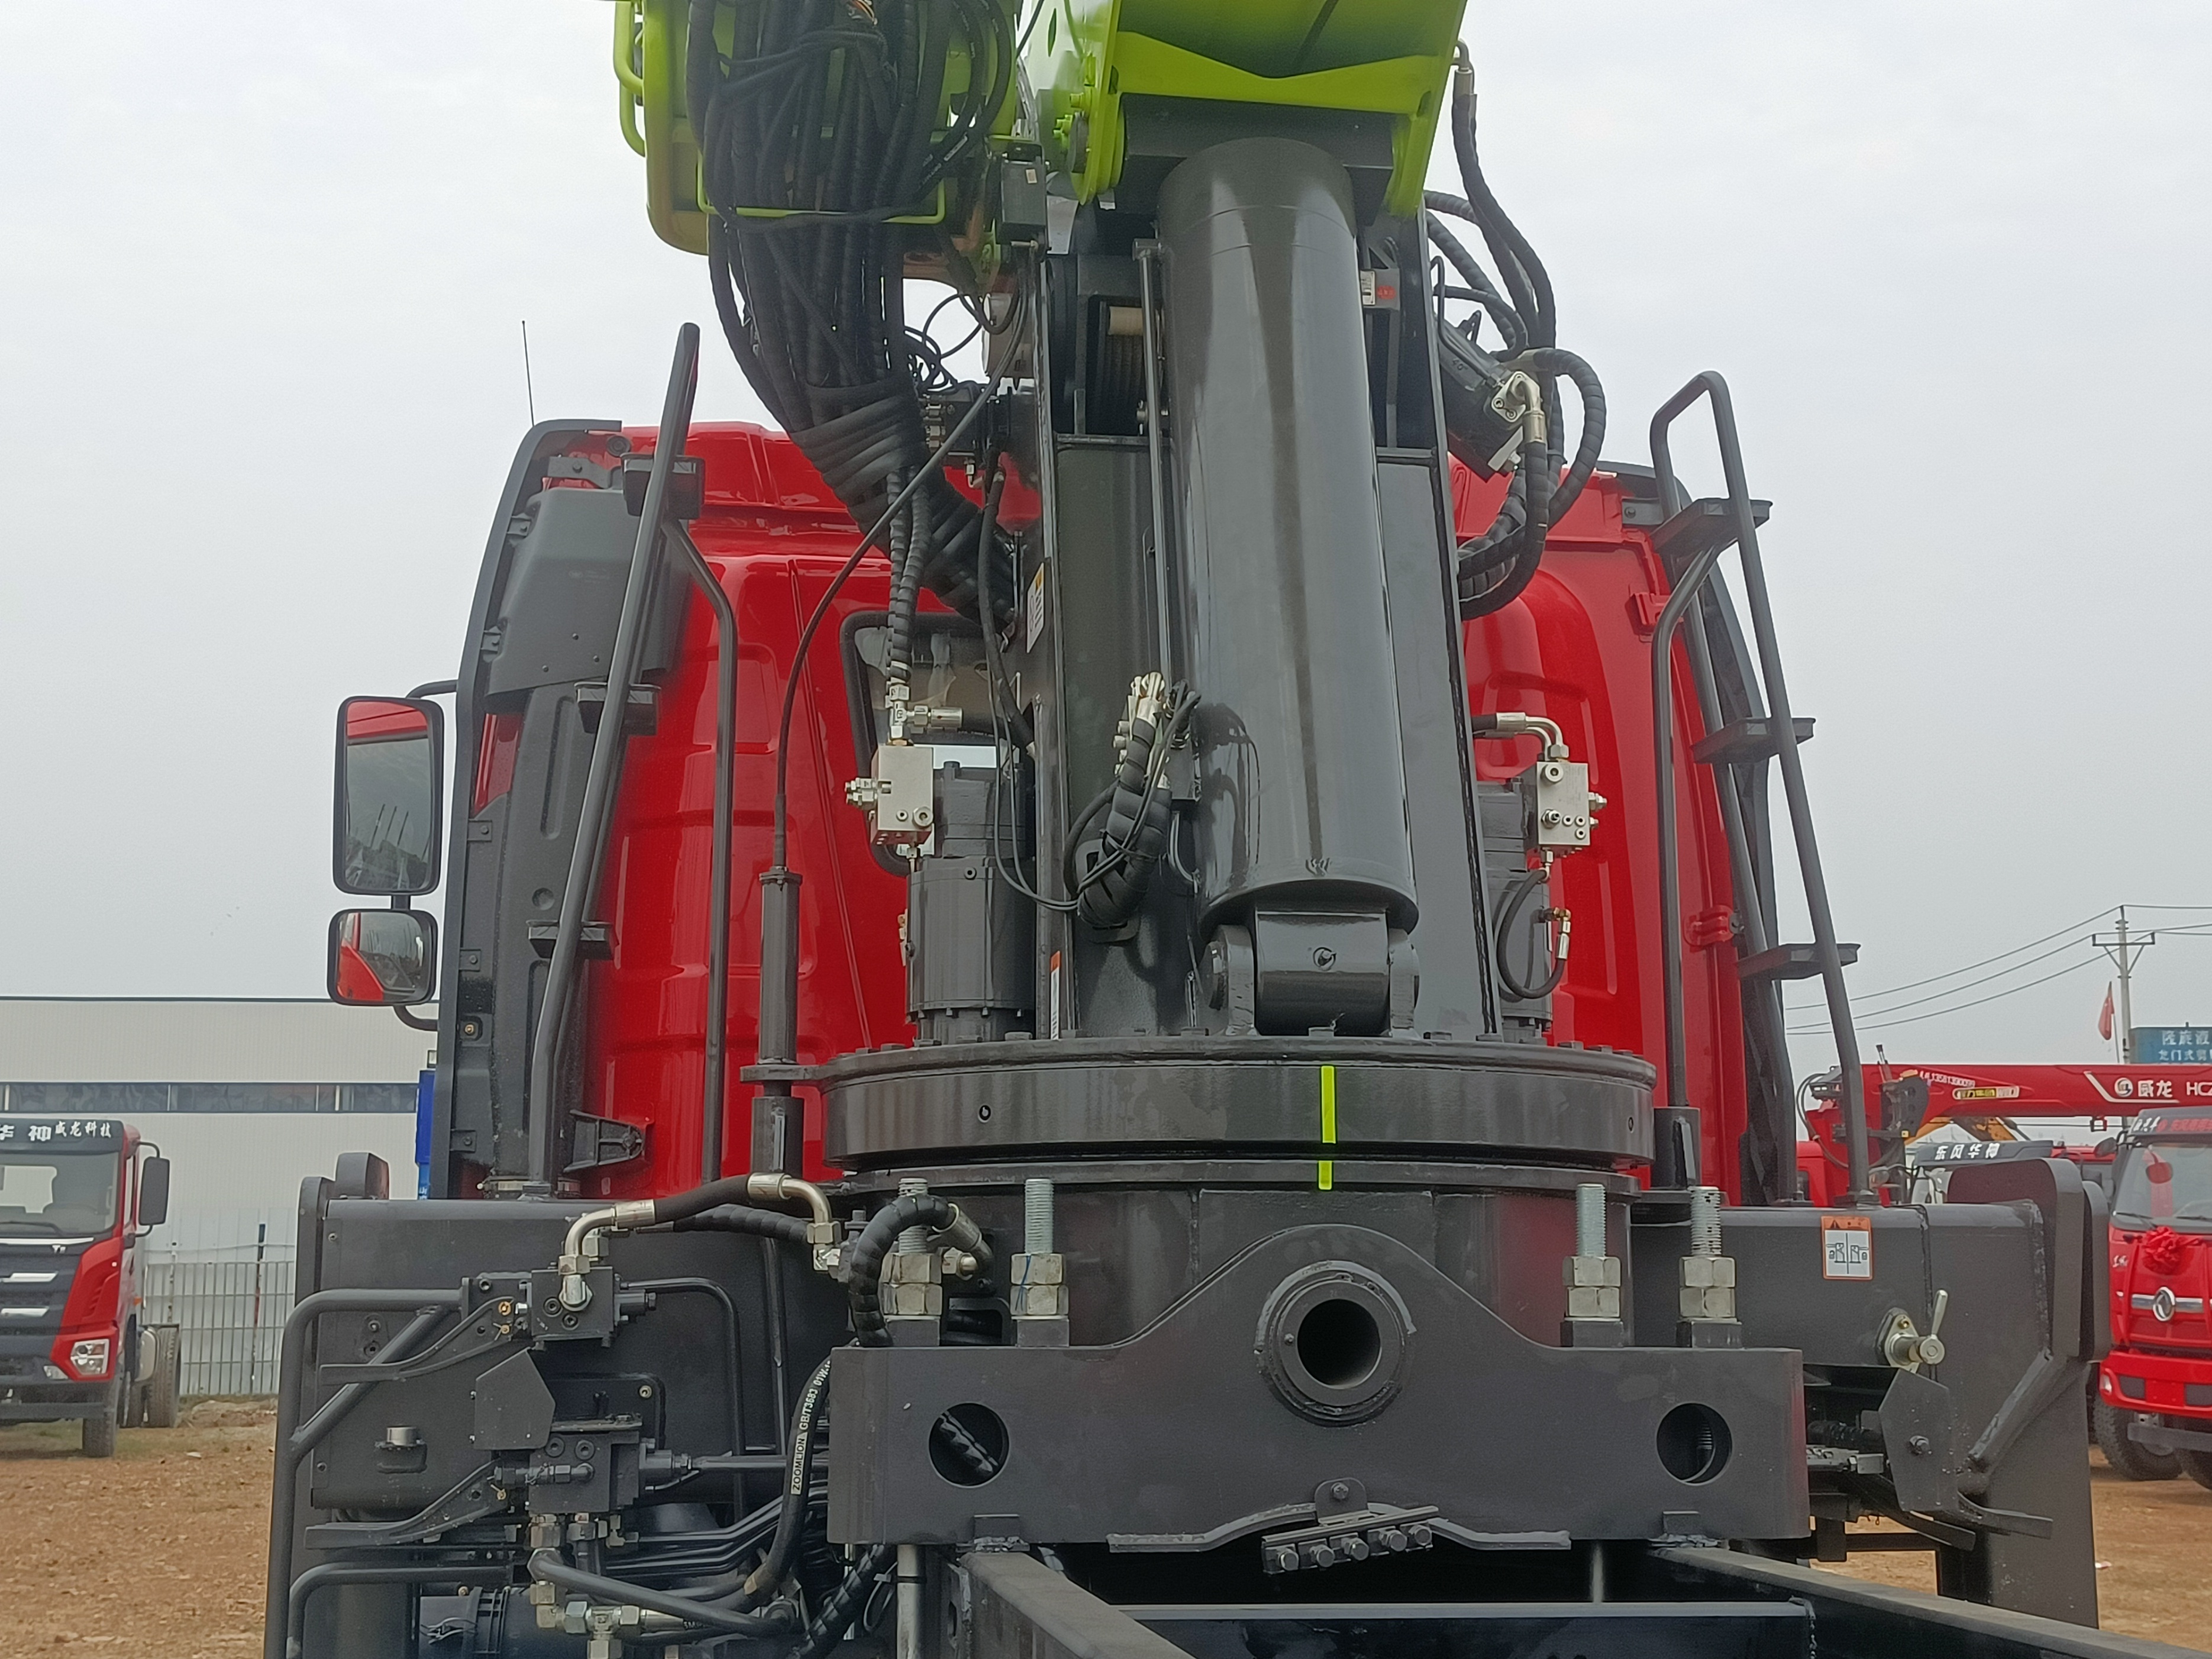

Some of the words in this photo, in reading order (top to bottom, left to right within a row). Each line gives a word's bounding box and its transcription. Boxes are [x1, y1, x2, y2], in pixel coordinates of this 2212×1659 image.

[1935, 1142, 2000, 1160] 东风华神
[793, 1438, 805, 1490] ZOOMLION
[799, 1389, 818, 1430] GB/T3683
